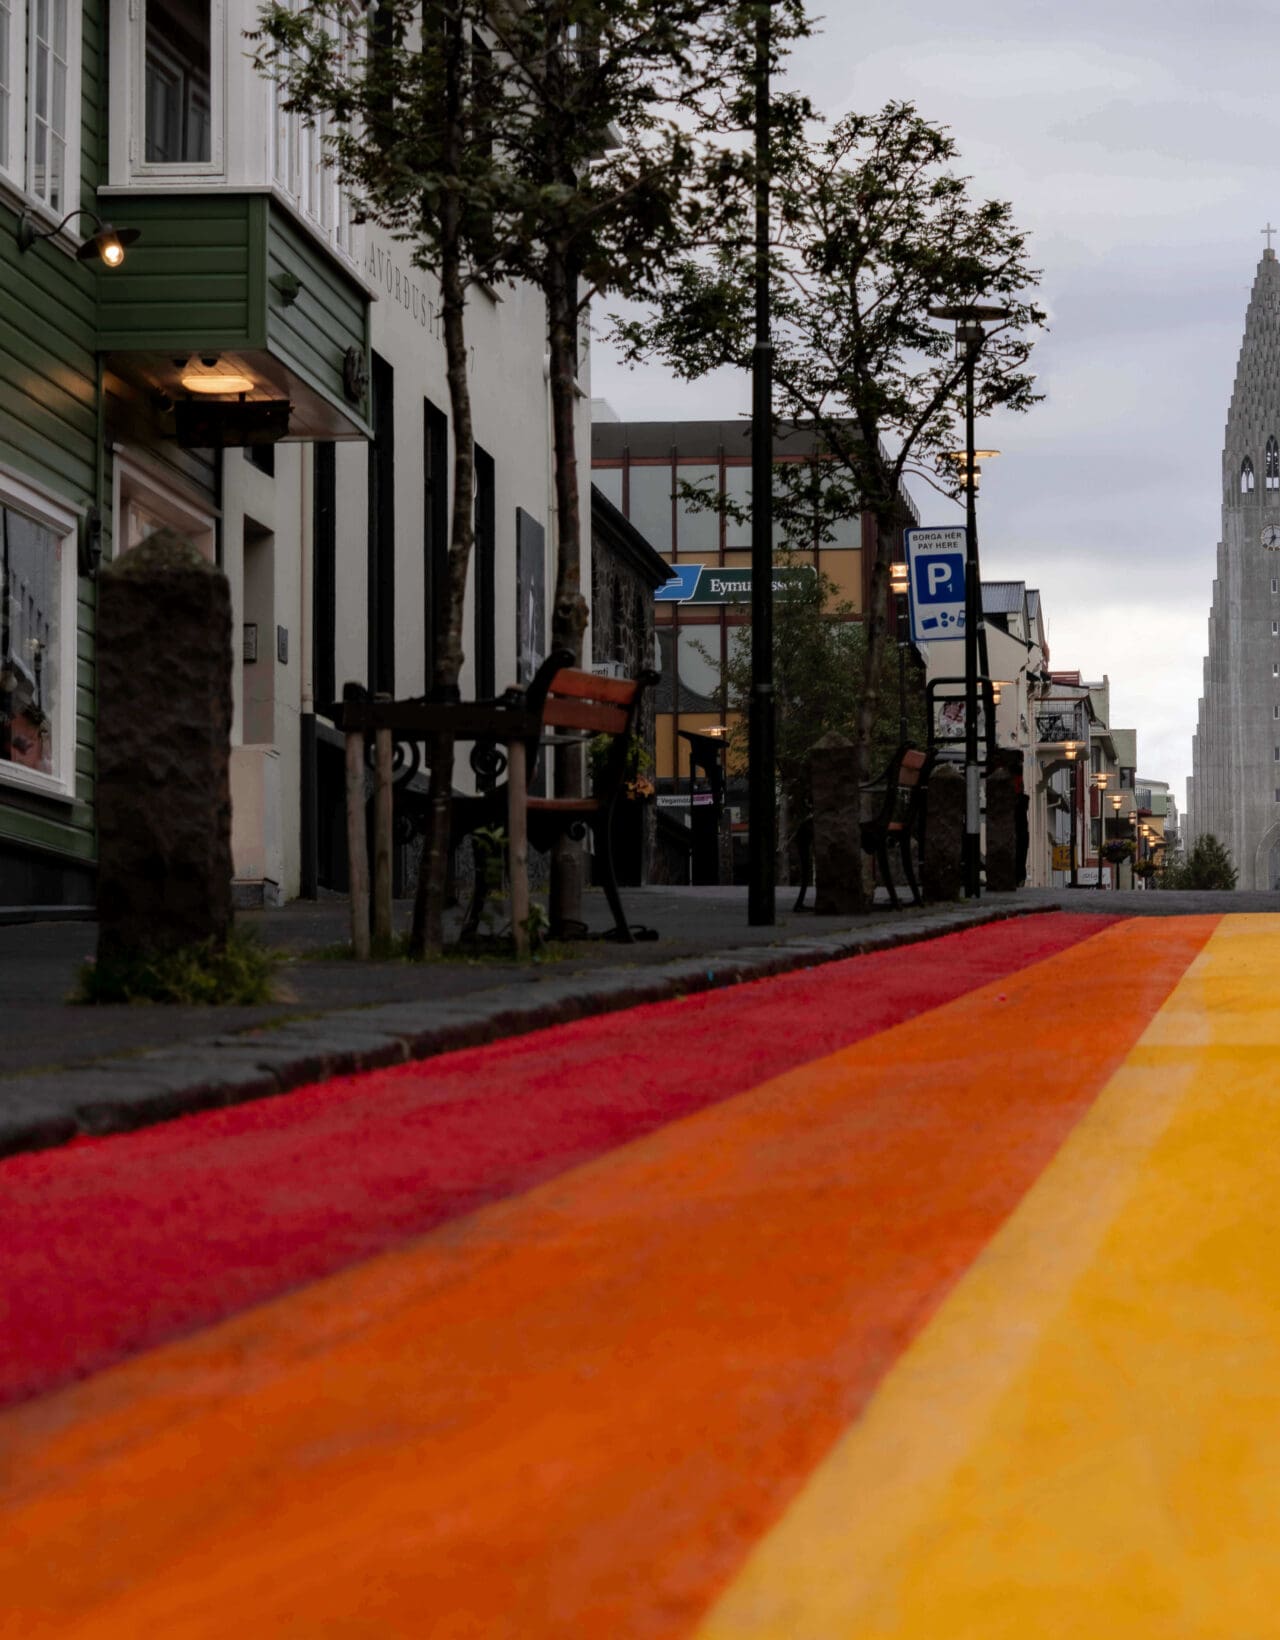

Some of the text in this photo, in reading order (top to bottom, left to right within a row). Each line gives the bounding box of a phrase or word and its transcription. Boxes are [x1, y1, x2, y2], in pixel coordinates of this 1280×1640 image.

[912, 533, 943, 542] BORGA
[917, 541, 959, 551] PAY HERE
